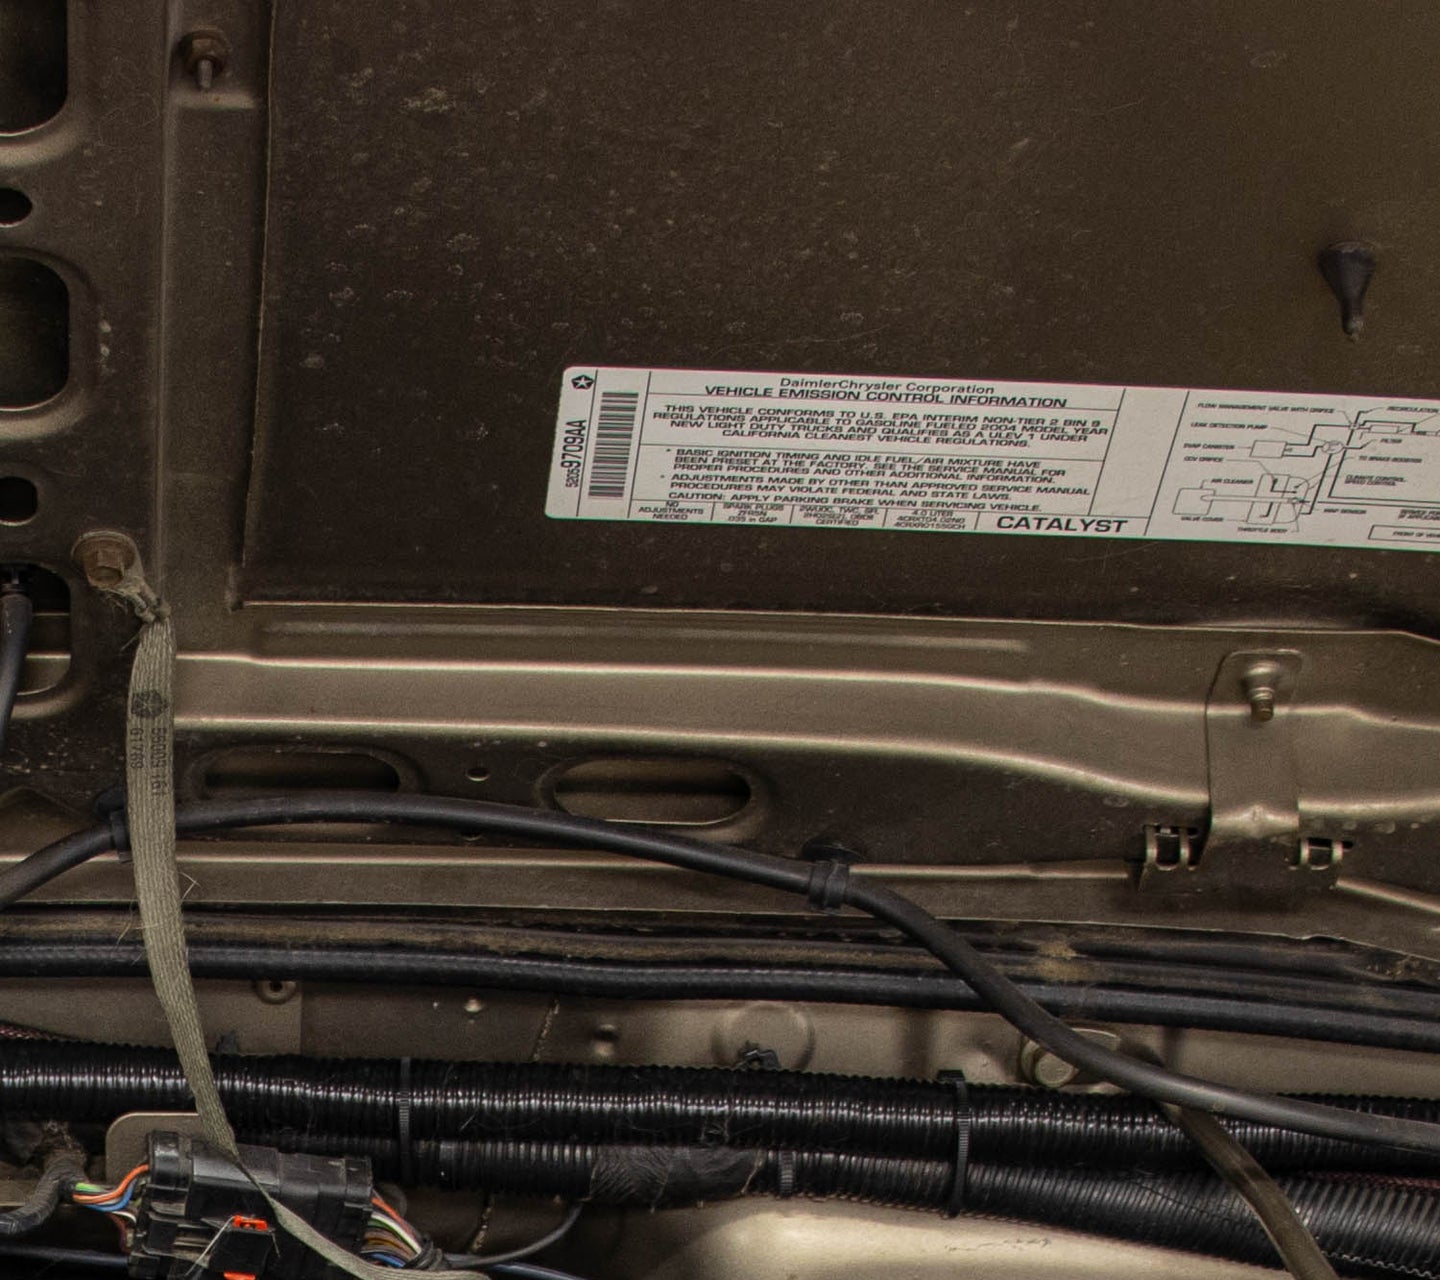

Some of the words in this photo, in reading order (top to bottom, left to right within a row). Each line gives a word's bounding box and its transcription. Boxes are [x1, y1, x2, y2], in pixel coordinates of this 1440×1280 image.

[779, 377, 901, 391] DaimlerChrysler
[905, 382, 995, 395] Corporation
[704, 385, 773, 397] VEHICLE
[778, 387, 860, 400] EMISSION
[865, 391, 945, 403] CONTROL
[949, 394, 1068, 408] INFORMATION
[653, 411, 745, 421] REGULATIONS
[750, 415, 830, 424] APPLICABLE
[855, 419, 920, 428] GASOLINE
[925, 421, 976, 430] FUELED
[980, 423, 1016, 431] 2004
[1020, 425, 1068, 433] MODEL
[1072, 427, 1108, 435] YEAR
[665, 404, 694, 412] THIS
[698, 405, 753, 414] VEHICLE
[757, 407, 834, 417] CONFORMS
[838, 410, 856, 418] TO
[891, 412, 917, 420] EPA
[922, 413, 978, 423] INTERIM
[1063, 419, 1087, 427] BIN
[707, 421, 745, 429] LIGHT
[790, 424, 843, 433] TRUCKS
[847, 426, 877, 434] AND
[881, 427, 948, 436] QUALIFIES
[988, 431, 1022, 439] ULEV
[1039, 433, 1087, 441] UNDER
[721, 429, 800, 438] CALIFORNIA
[804, 432, 871, 441] CLEANEST
[876, 435, 931, 443] VEHICLE
[674, 455, 707, 463] BEEN
[711, 457, 757, 465] PRESET
[927, 465, 978, 473] SERVICE
[982, 467, 1037, 475] MANUAL
[676, 448, 713, 456] BASIC
[717, 450, 771, 458] IGNITION
[775, 452, 819, 460] TIMING
[885, 456, 944, 464] FUEL/AIR
[947, 458, 1003, 466] MIXTURE
[1006, 460, 1040, 468] HAVE
[673, 463, 722, 471] PROPER
[727, 465, 809, 474] PROCEDURES
[844, 469, 885, 477] OTHER
[889, 471, 963, 480] ADDITIONAL
[966, 474, 1056, 483] INFORMATION.
[670, 481, 752, 491] PROCEDURES
[788, 486, 837, 494] VIOLATE
[841, 488, 895, 496] FEDERAL
[972, 492, 1012, 500] LAWS.
[671, 473, 764, 483] ADJUSTMENTS
[829, 479, 870, 487] OTHER
[911, 482, 977, 490] APPROVED
[981, 484, 1032, 492] SERVICE
[1035, 487, 1091, 495] MANUAL
[638, 506, 703, 514] ADJUSTMENTS
[730, 494, 769, 502] APPLY
[773, 495, 828, 504] PARKING
[832, 497, 874, 505] BRAKE
[877, 499, 917, 507] WHEN
[920, 500, 986, 509] SERVICING
[989, 503, 1042, 511] VEHICLE.
[997, 515, 1128, 533] CATALYST
